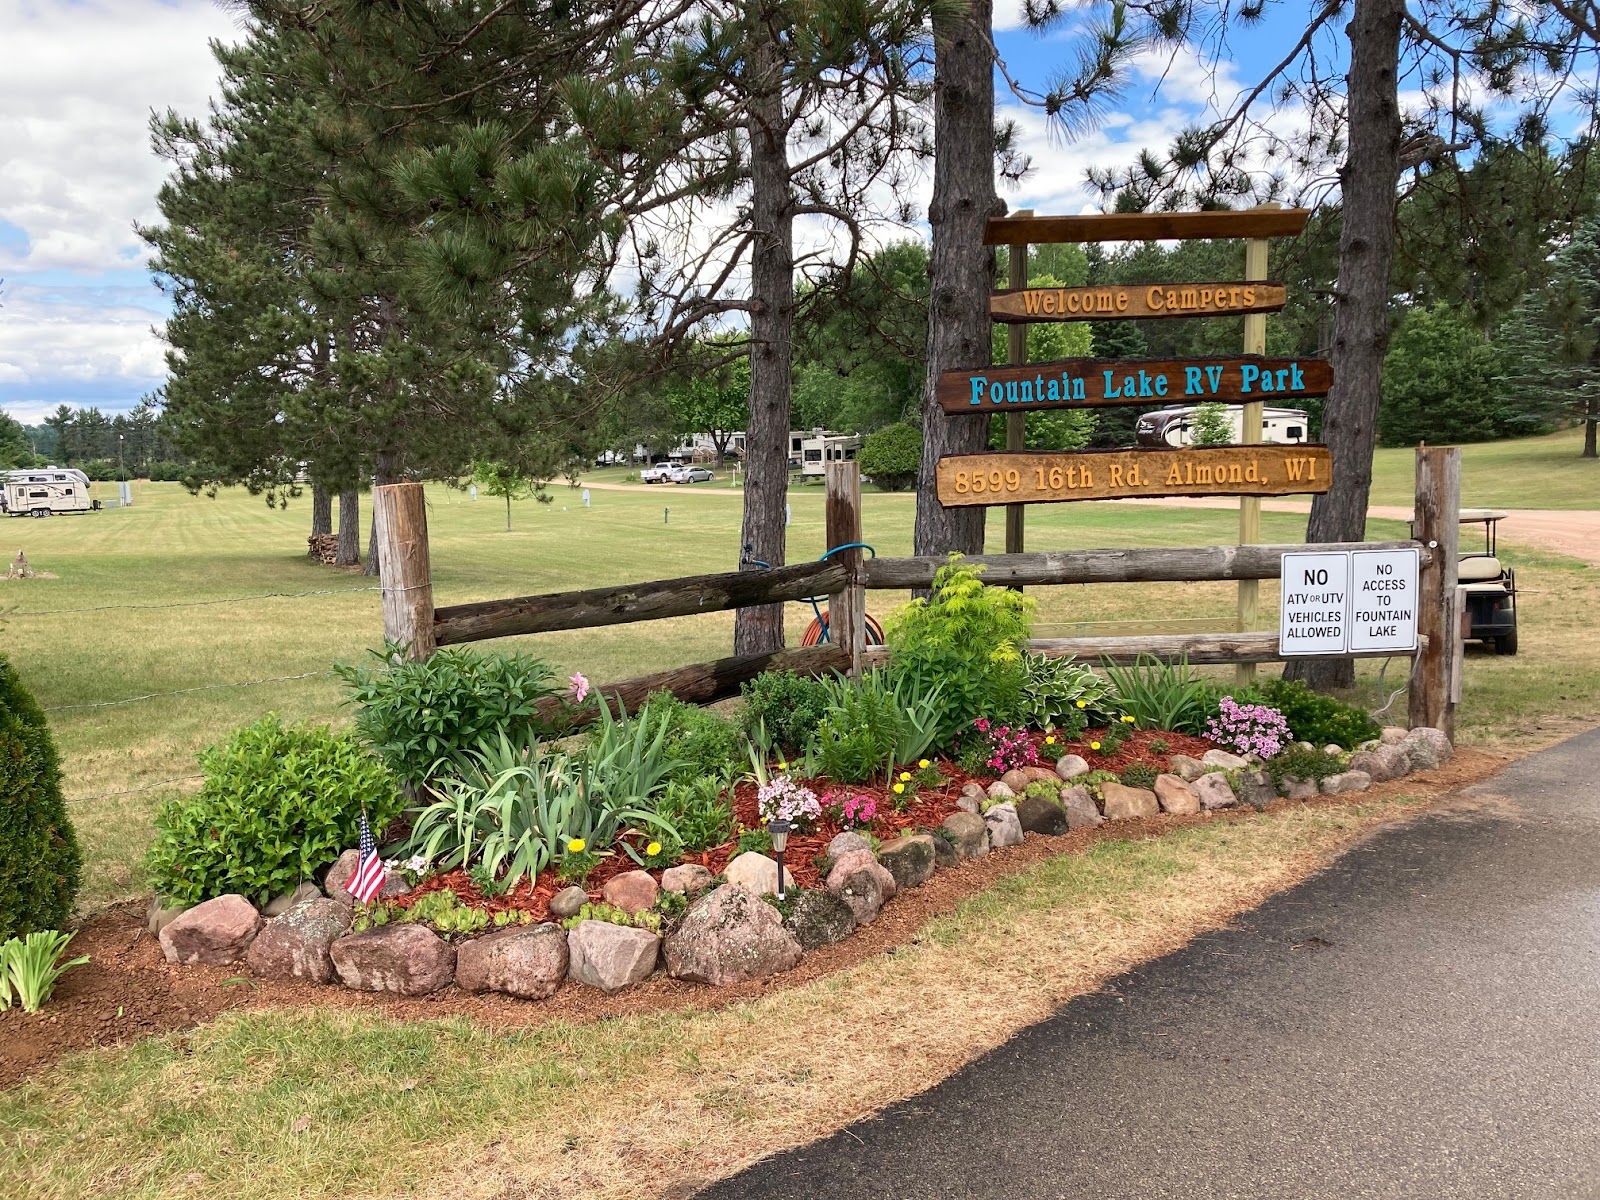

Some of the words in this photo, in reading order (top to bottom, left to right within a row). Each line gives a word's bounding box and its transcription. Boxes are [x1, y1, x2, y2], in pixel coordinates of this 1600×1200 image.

[1023, 289, 1128, 315] Welcome
[1146, 285, 1256, 311] Campers
[970, 371, 1086, 405] Fountain
[1103, 369, 1168, 399] Lake
[1184, 365, 1224, 394] RV
[1240, 363, 1305, 393] Park
[955, 468, 1021, 494] 8599
[1036, 464, 1094, 491] 16th
[1109, 463, 1149, 488] Rd.
[1166, 460, 1268, 486] Almond,
[1285, 457, 1317, 482] WI
[1376, 564, 1393, 576] NO
[1304, 569, 1328, 586] NO
[1362, 579, 1406, 592] ACCESS
[1287, 593, 1309, 605] ATV
[1310, 595, 1321, 603] OR
[1321, 592, 1344, 604] UTV
[1377, 595, 1391, 606] TO
[1288, 611, 1341, 623] VEHICLES
[1356, 610, 1412, 622] FOUNTAIN
[1287, 626, 1341, 638] ALLOWED
[1369, 625, 1397, 637] LAKE
